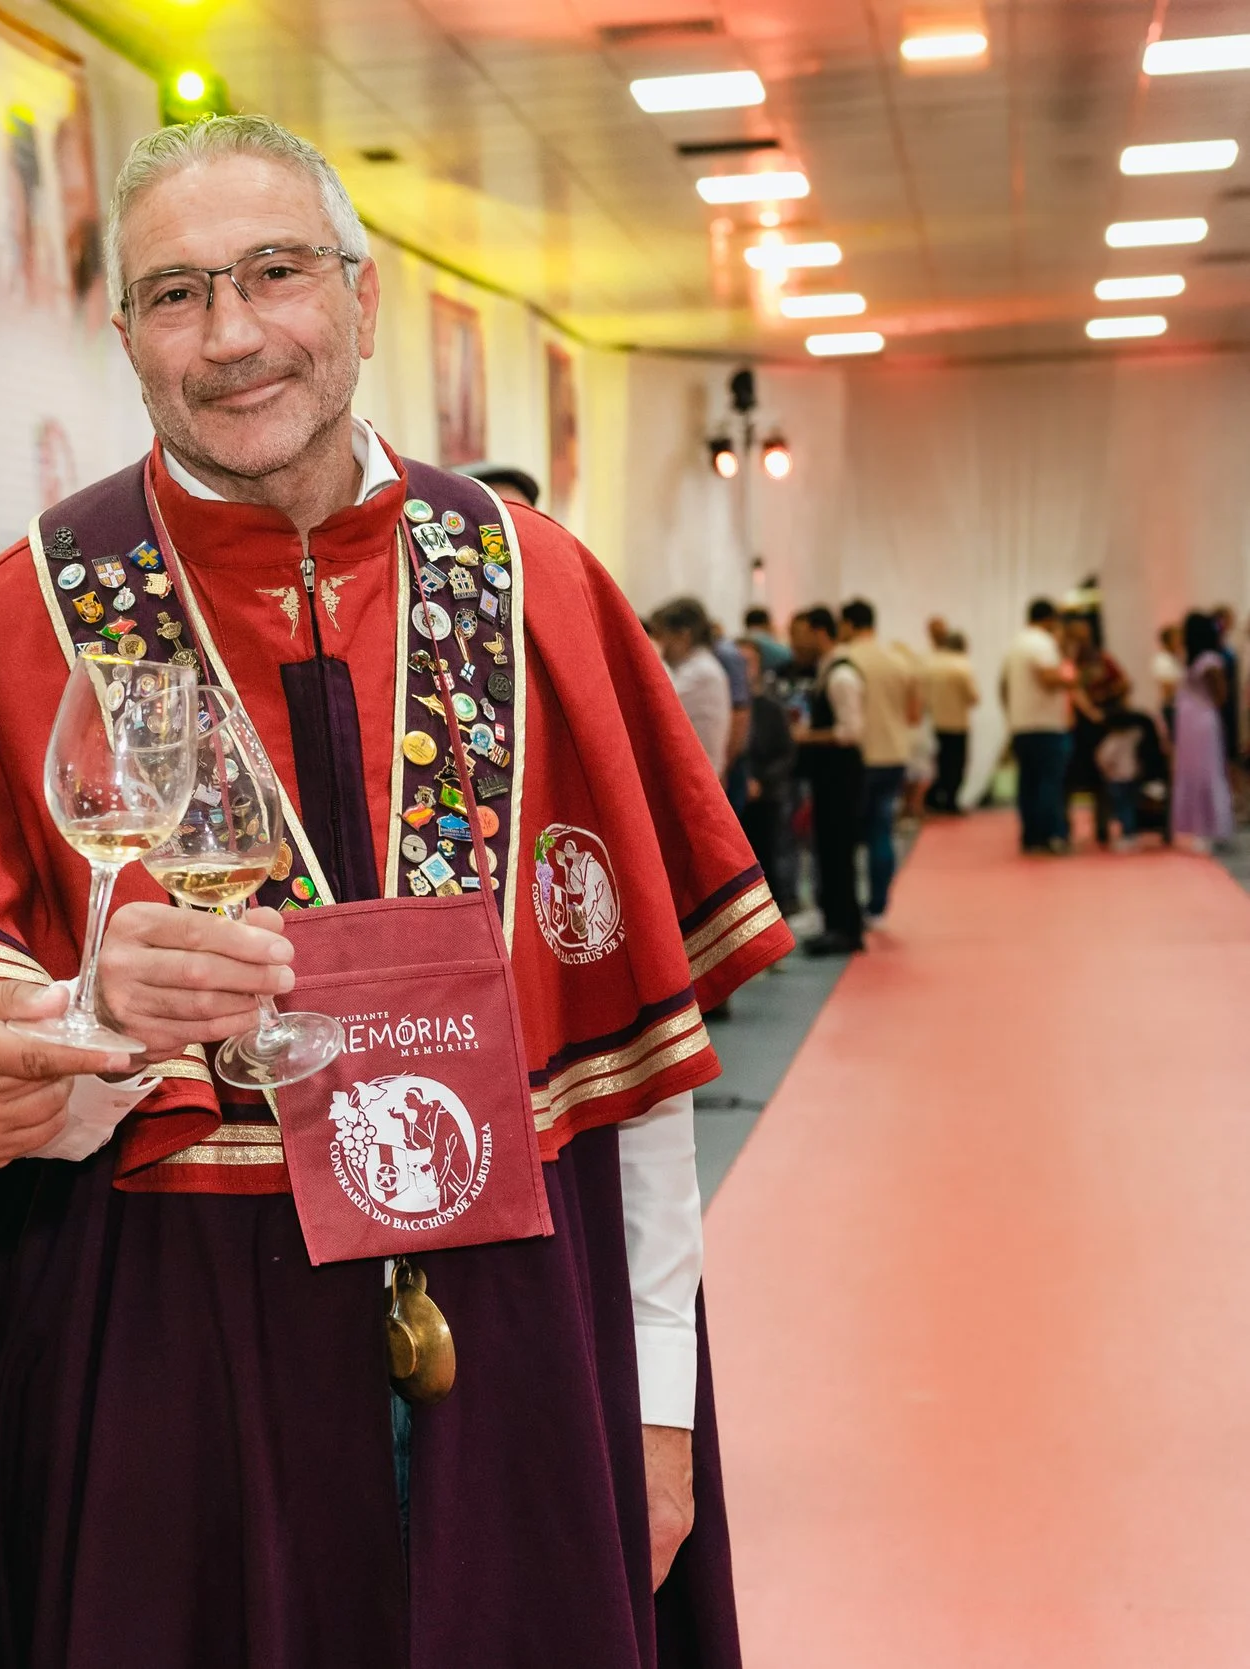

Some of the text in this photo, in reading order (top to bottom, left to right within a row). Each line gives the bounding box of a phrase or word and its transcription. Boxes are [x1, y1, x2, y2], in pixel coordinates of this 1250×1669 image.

[603, 938, 619, 955] DE
[335, 1011, 390, 1024] TAURANTE
[401, 1041, 480, 1057] MEMORIES
[329, 1122, 493, 1231] CONFRARIA DO BACCHUS DE ALBUFEIRA
